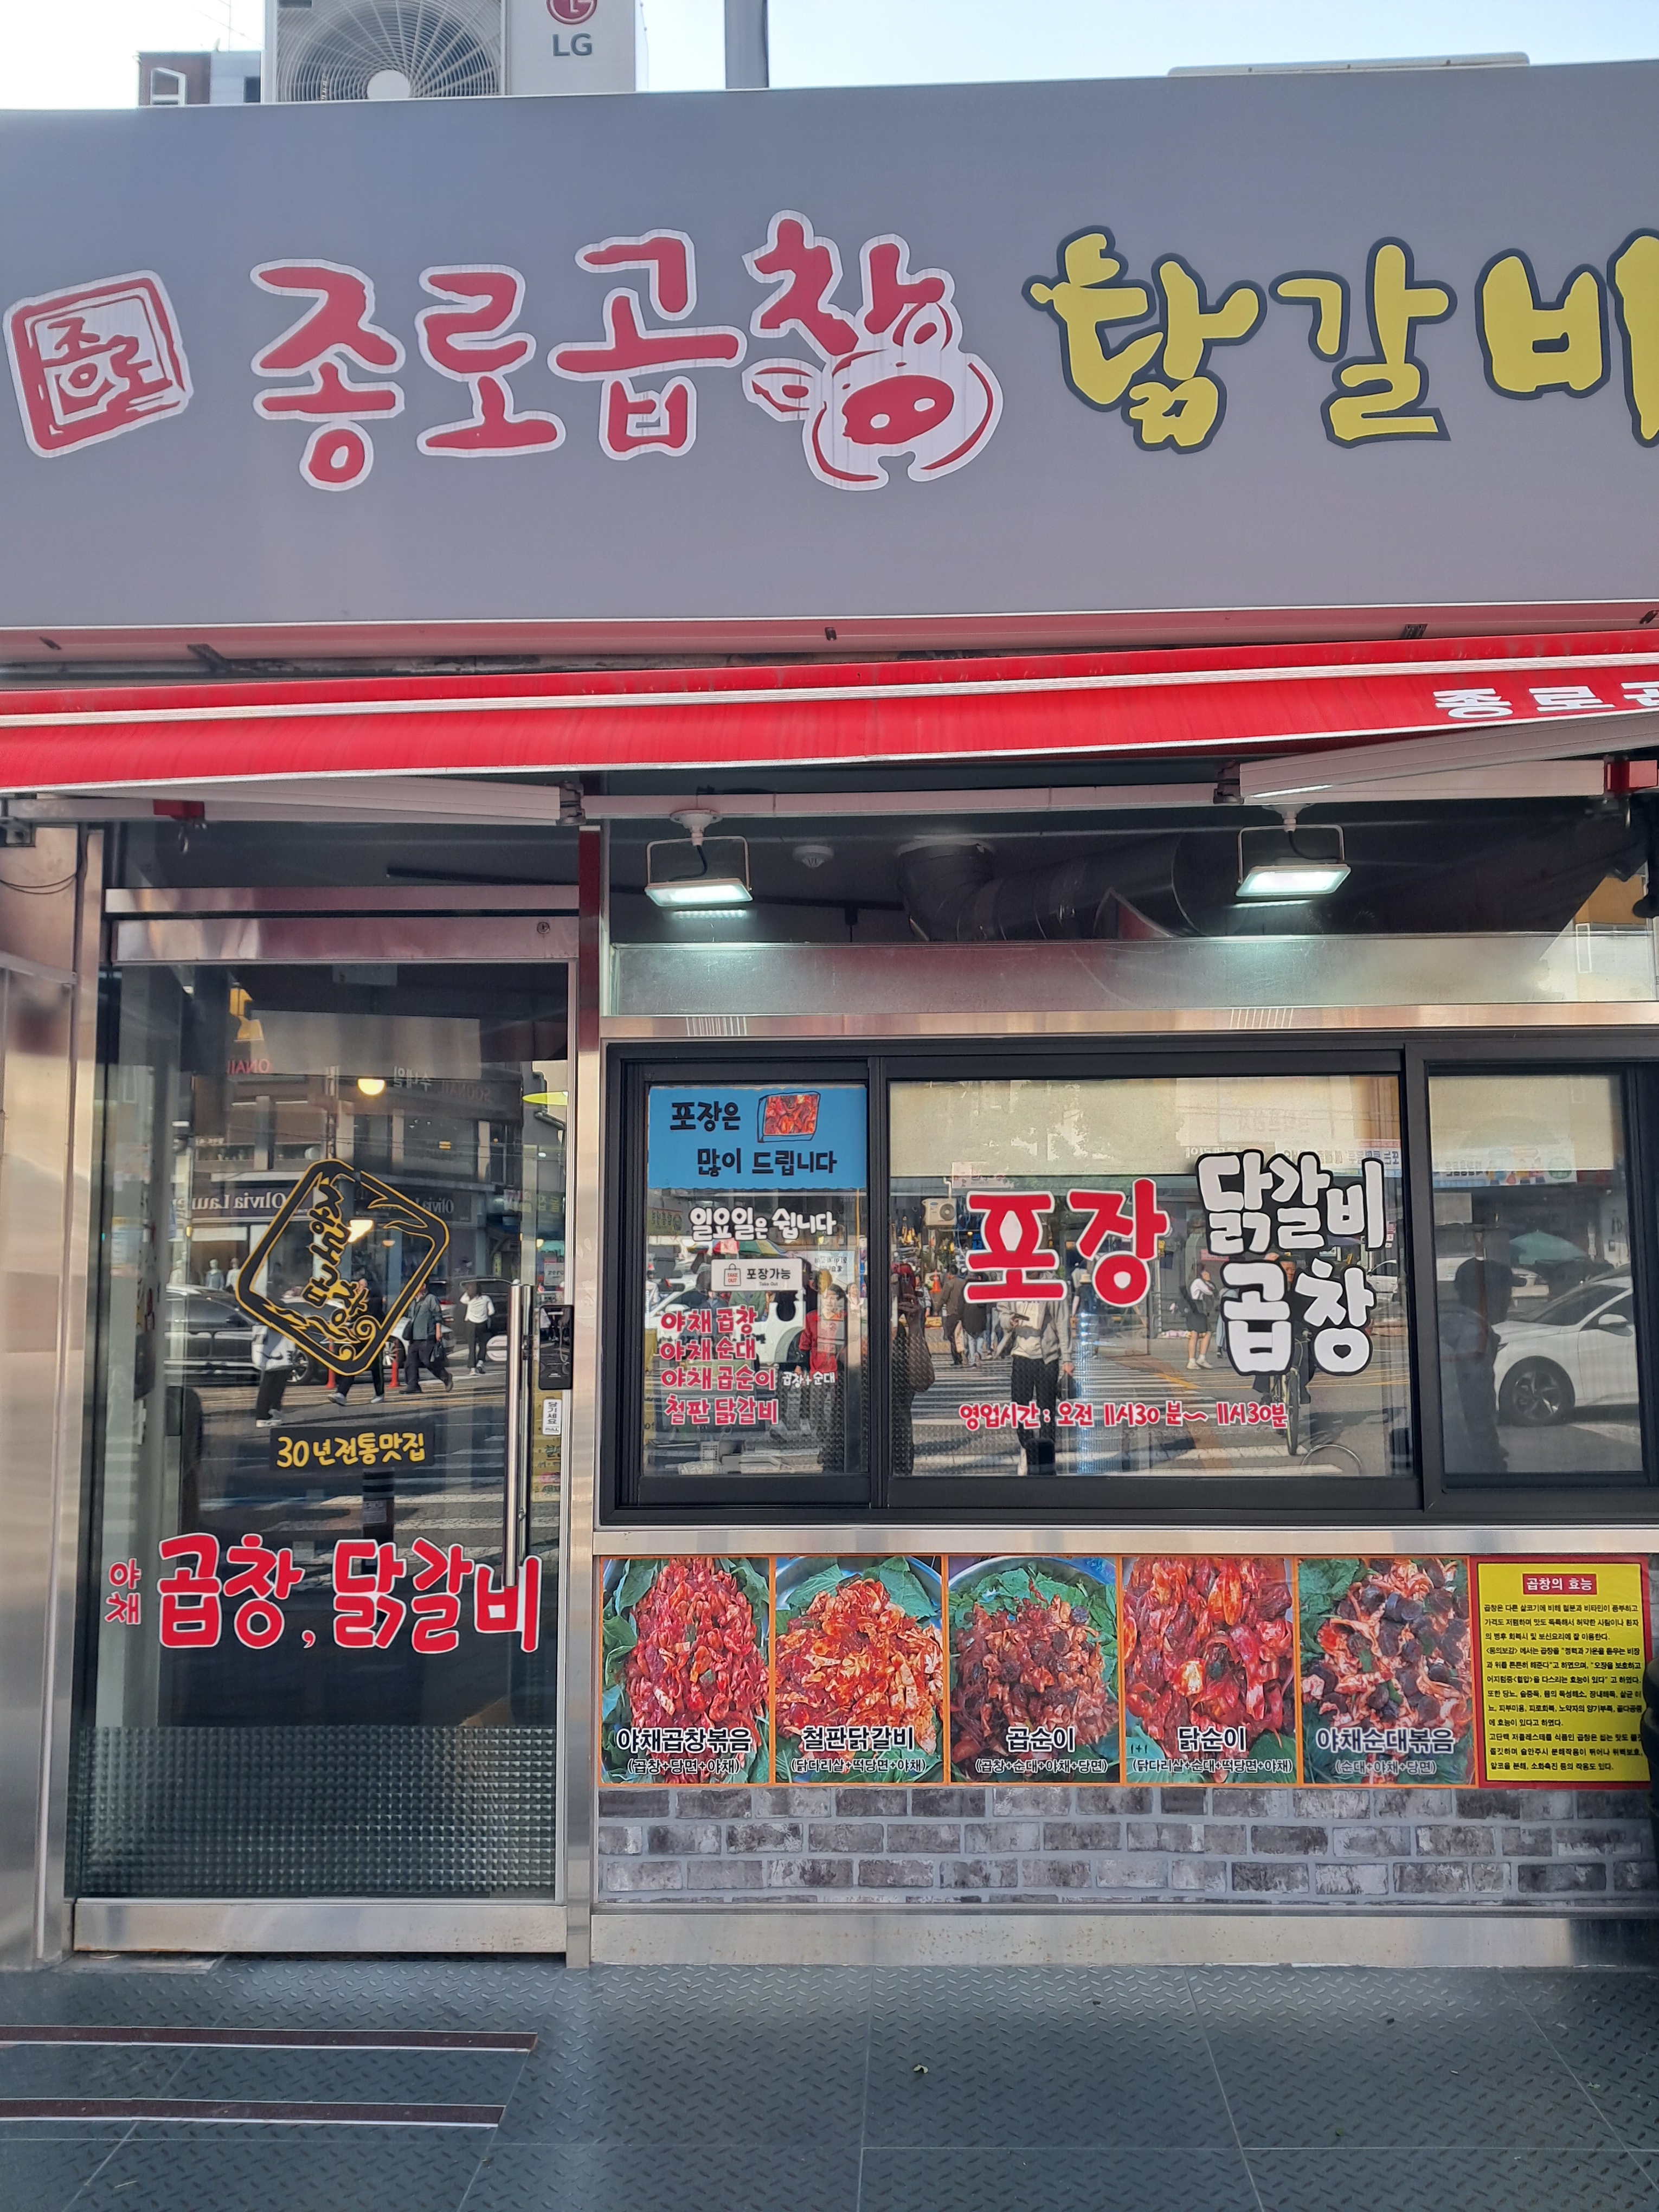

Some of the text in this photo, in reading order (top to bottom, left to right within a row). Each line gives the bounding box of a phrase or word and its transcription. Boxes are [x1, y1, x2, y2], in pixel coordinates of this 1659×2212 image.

[552, 33, 593, 56] LG
[670, 1101, 741, 1132] 포장은
[697, 1147, 838, 1177] 많이 드립니다
[1194, 1148, 1387, 1258] 닭갈비
[689, 1206, 769, 1242] 일요일은
[771, 1207, 837, 1242] 쉽니다
[963, 1177, 1170, 1308] 포장
[747, 1268, 791, 1280] 포장가능
[660, 1305, 758, 1334] 야채 곱창
[1220, 1256, 1377, 1376] 곱창
[659, 1336, 757, 1362] 야채 순대
[660, 1366, 712, 1391] 야채
[716, 1364, 776, 1391] 곱순이
[546, 1401, 558, 1424] 당기세요
[664, 1394, 780, 1425] 철판 닭갈비
[1056, 1399, 1095, 1427] 오전
[105, 1557, 142, 1626] 야채
[157, 1532, 543, 1654] 곱창, 닭갈비
[1526, 1577, 1593, 1591] 곱창의 효능
[1505, 1604, 1519, 1612] 다른
[1547, 1604, 1561, 1612] 비해
[1584, 1604, 1610, 1612] 비타민이
[1484, 1618, 1504, 1626] 가격도
[1533, 1618, 1547, 1626] 맛도
[1485, 1632, 1492, 1641] 의
[1486, 1661, 1493, 1670] 과
[1541, 1675, 1568, 1684] 다스리는
[1487, 1690, 1501, 1699] 또한
[1497, 1719, 1517, 1727] 효능이
[1519, 1719, 1540, 1727] 있다고
[1541, 1719, 1564, 1727] 하였다.
[616, 1727, 753, 1755] 야채곱창볶음
[801, 1725, 916, 1752] 철판닭갈비
[1006, 1726, 1076, 1753] 곱순이
[1176, 1726, 1247, 1752] 닭순이
[1316, 1727, 1456, 1755] 야채순대볶음
